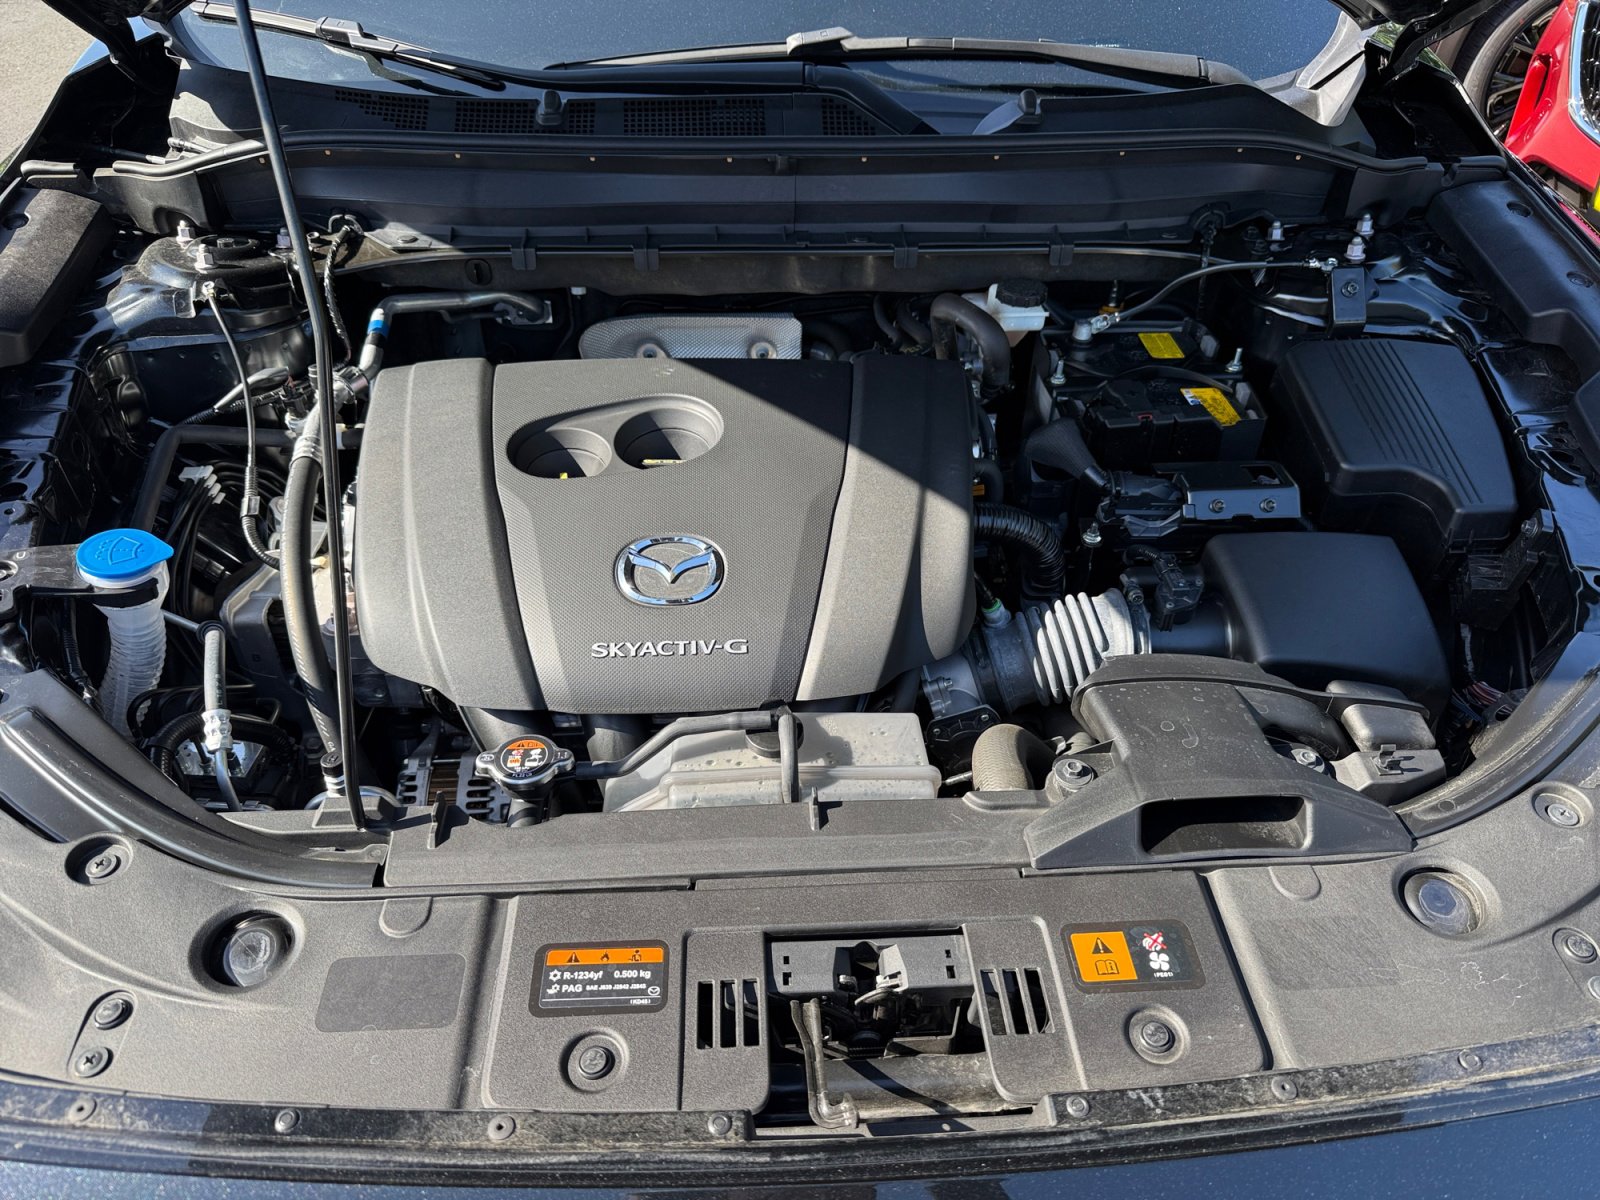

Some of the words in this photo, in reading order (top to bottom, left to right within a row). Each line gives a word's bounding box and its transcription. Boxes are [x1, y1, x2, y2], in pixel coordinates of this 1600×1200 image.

[591, 639, 749, 658] SKYACTIV-G
[563, 970, 603, 981] R-1234yf
[614, 970, 638, 978] 0.500
[640, 970, 652, 980] kg
[562, 984, 582, 992] PAG
